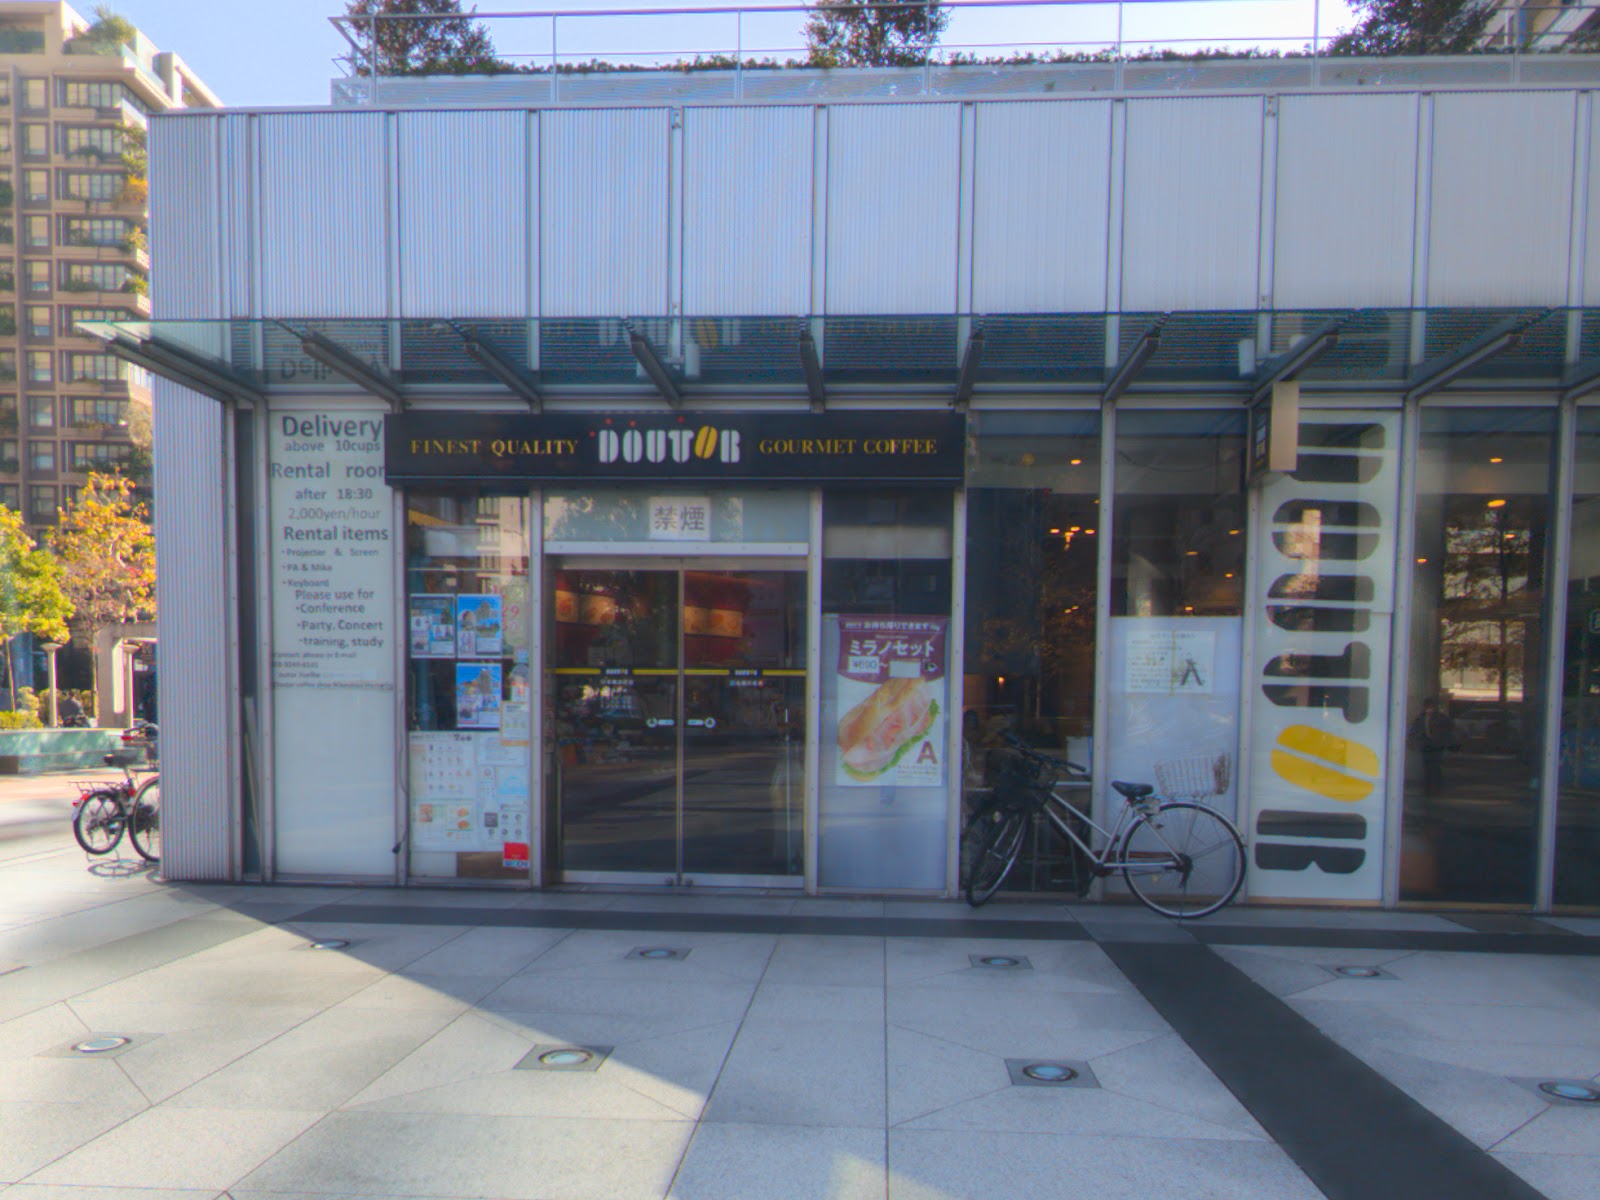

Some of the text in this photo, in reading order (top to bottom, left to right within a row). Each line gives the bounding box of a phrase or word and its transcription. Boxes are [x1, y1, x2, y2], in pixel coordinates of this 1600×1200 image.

[282, 414, 383, 441] Delivery
[285, 439, 381, 453] above 10cups
[410, 426, 937, 463] FINEST QUALITY DOUTOR GOURMET COFFEE
[271, 461, 331, 478] Rental
[295, 488, 373, 500] after 18:30
[654, 505, 705, 531] 禁煙
[283, 525, 389, 540] Rental items
[295, 587, 374, 600] Please use for
[300, 603, 365, 614] Conference
[337, 619, 384, 631] Concert
[351, 636, 384, 648] study
[849, 639, 935, 657] ミラノセット
[1255, 422, 1387, 874] DOUTOR
[916, 740, 938, 764] A
